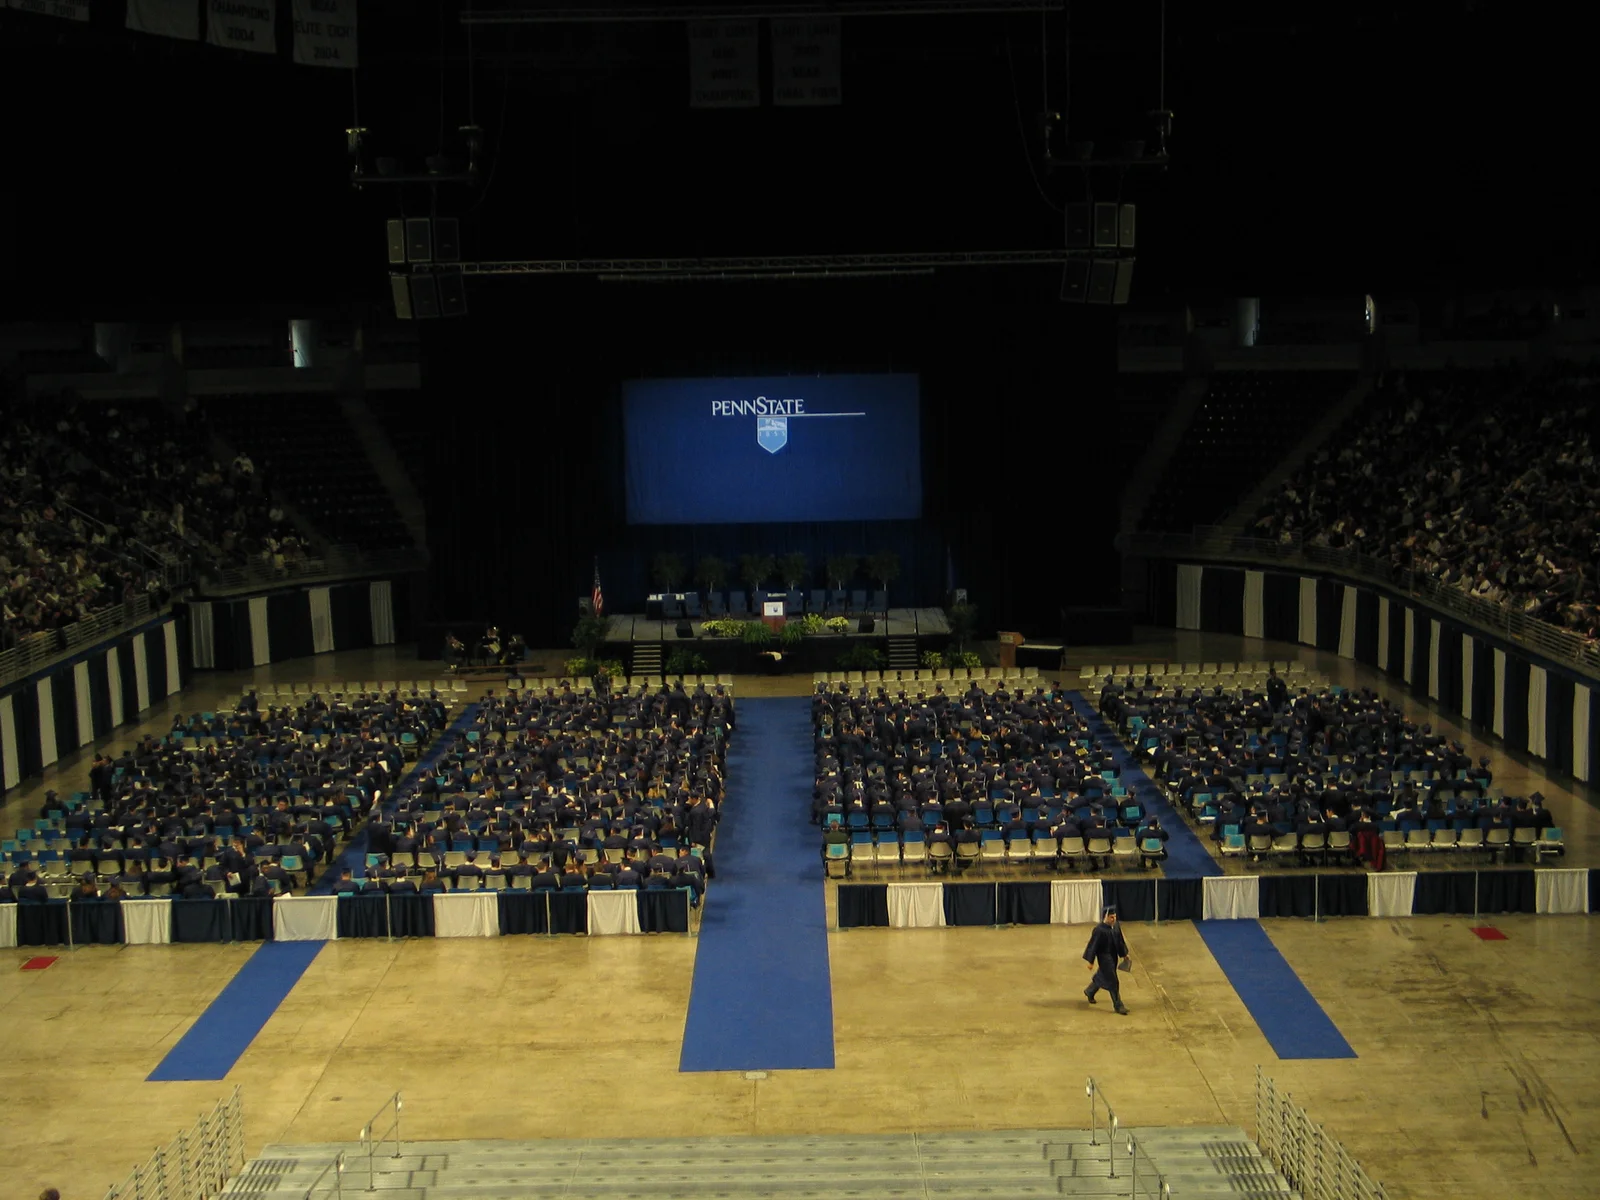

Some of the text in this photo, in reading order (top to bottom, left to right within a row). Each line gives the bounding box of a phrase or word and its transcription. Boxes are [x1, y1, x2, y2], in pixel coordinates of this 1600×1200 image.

[211, 1, 270, 21] CHAMPIONS
[227, 26, 255, 42] 2004
[295, 20, 321, 35] ELITE
[313, 46, 340, 60] 2004
